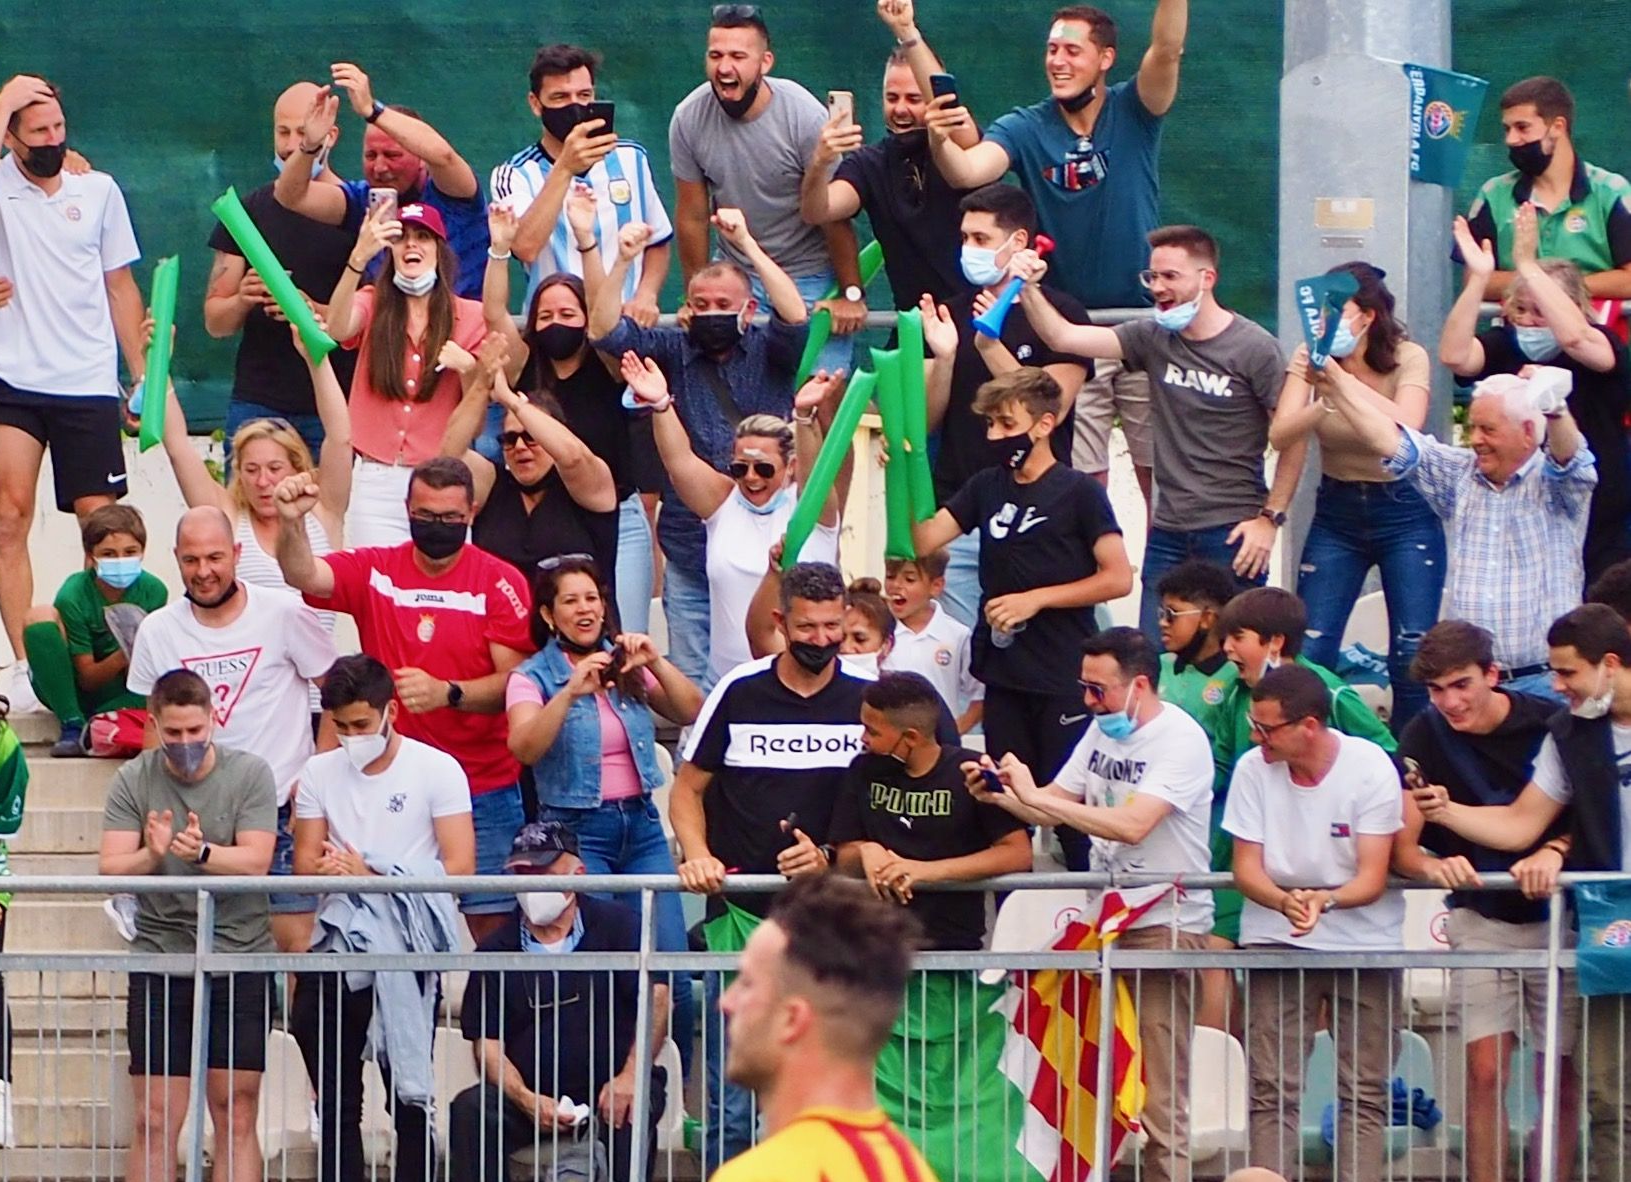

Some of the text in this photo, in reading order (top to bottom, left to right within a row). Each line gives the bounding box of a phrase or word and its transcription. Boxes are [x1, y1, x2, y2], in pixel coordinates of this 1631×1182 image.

[1163, 362, 1233, 398] RAW.
[193, 656, 248, 678] GUESS
[750, 734, 866, 756] Reebok
